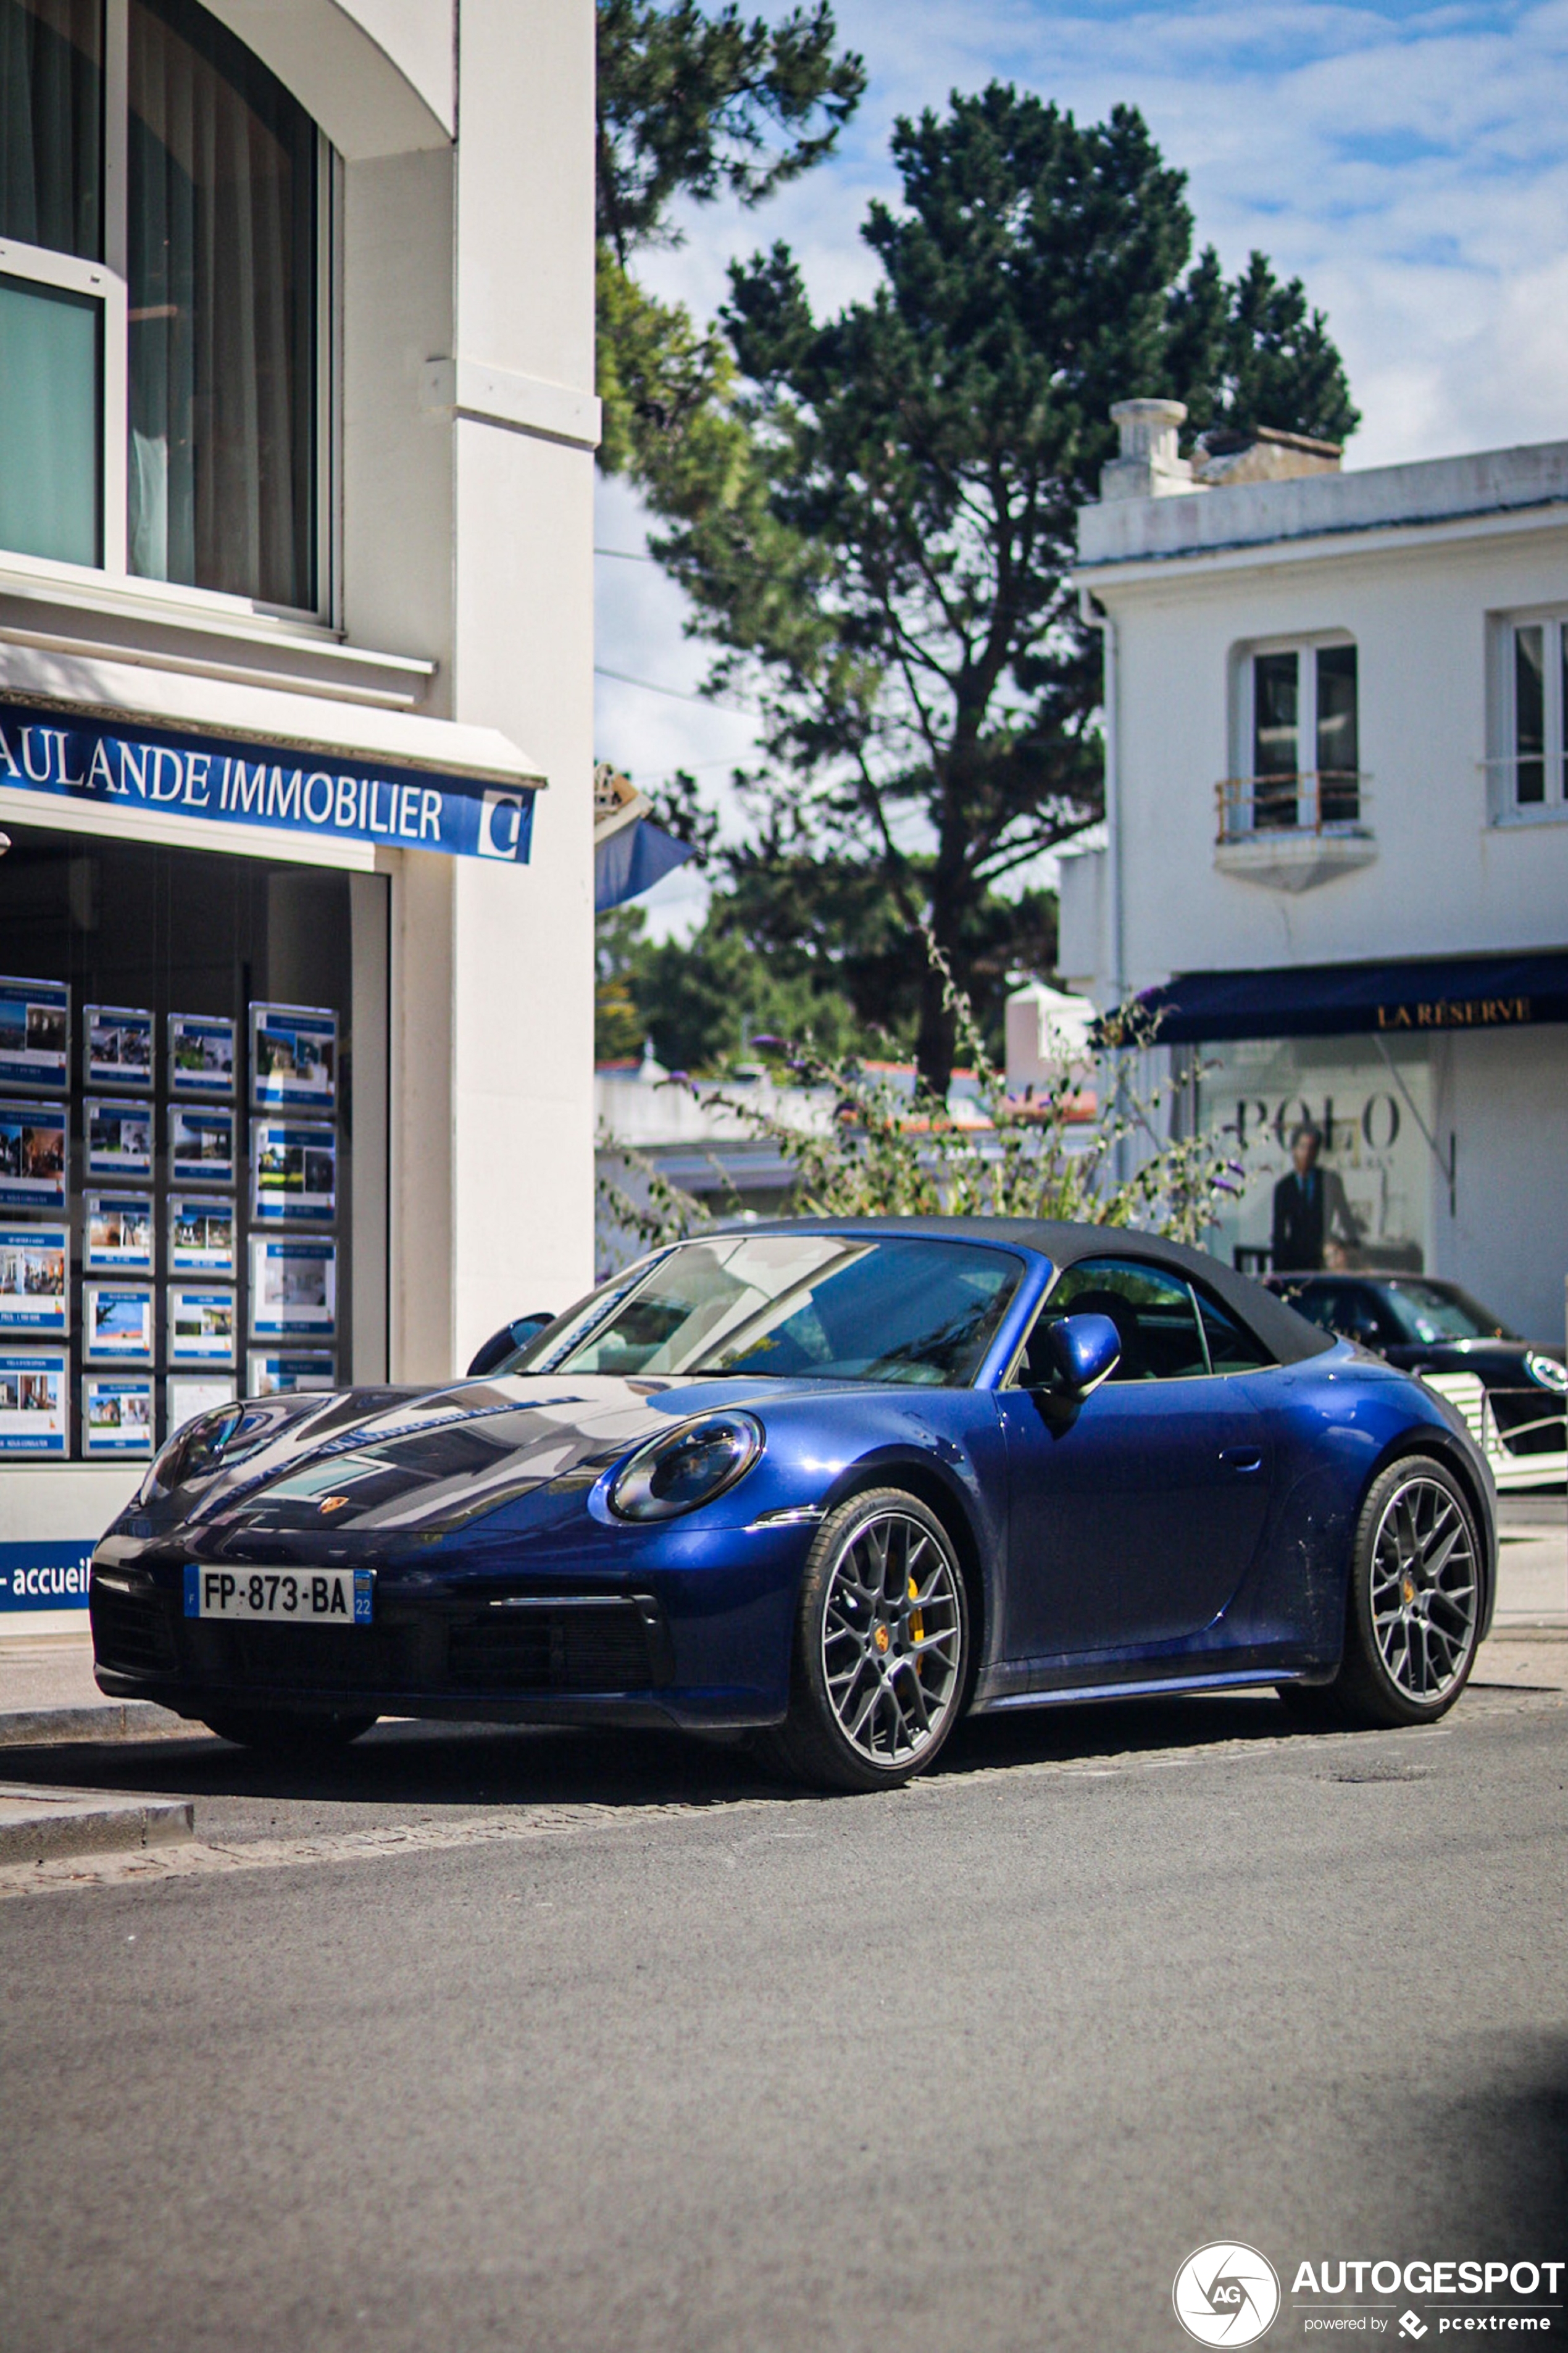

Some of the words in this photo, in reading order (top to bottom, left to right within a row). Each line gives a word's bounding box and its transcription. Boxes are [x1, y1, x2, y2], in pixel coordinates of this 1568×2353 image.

[219, 757, 443, 841] IMMOBILIER
[1377, 1004, 1412, 1029] LA
[204, 1573, 348, 1615] FP-873-BA
[356, 1599, 370, 1615] 22
